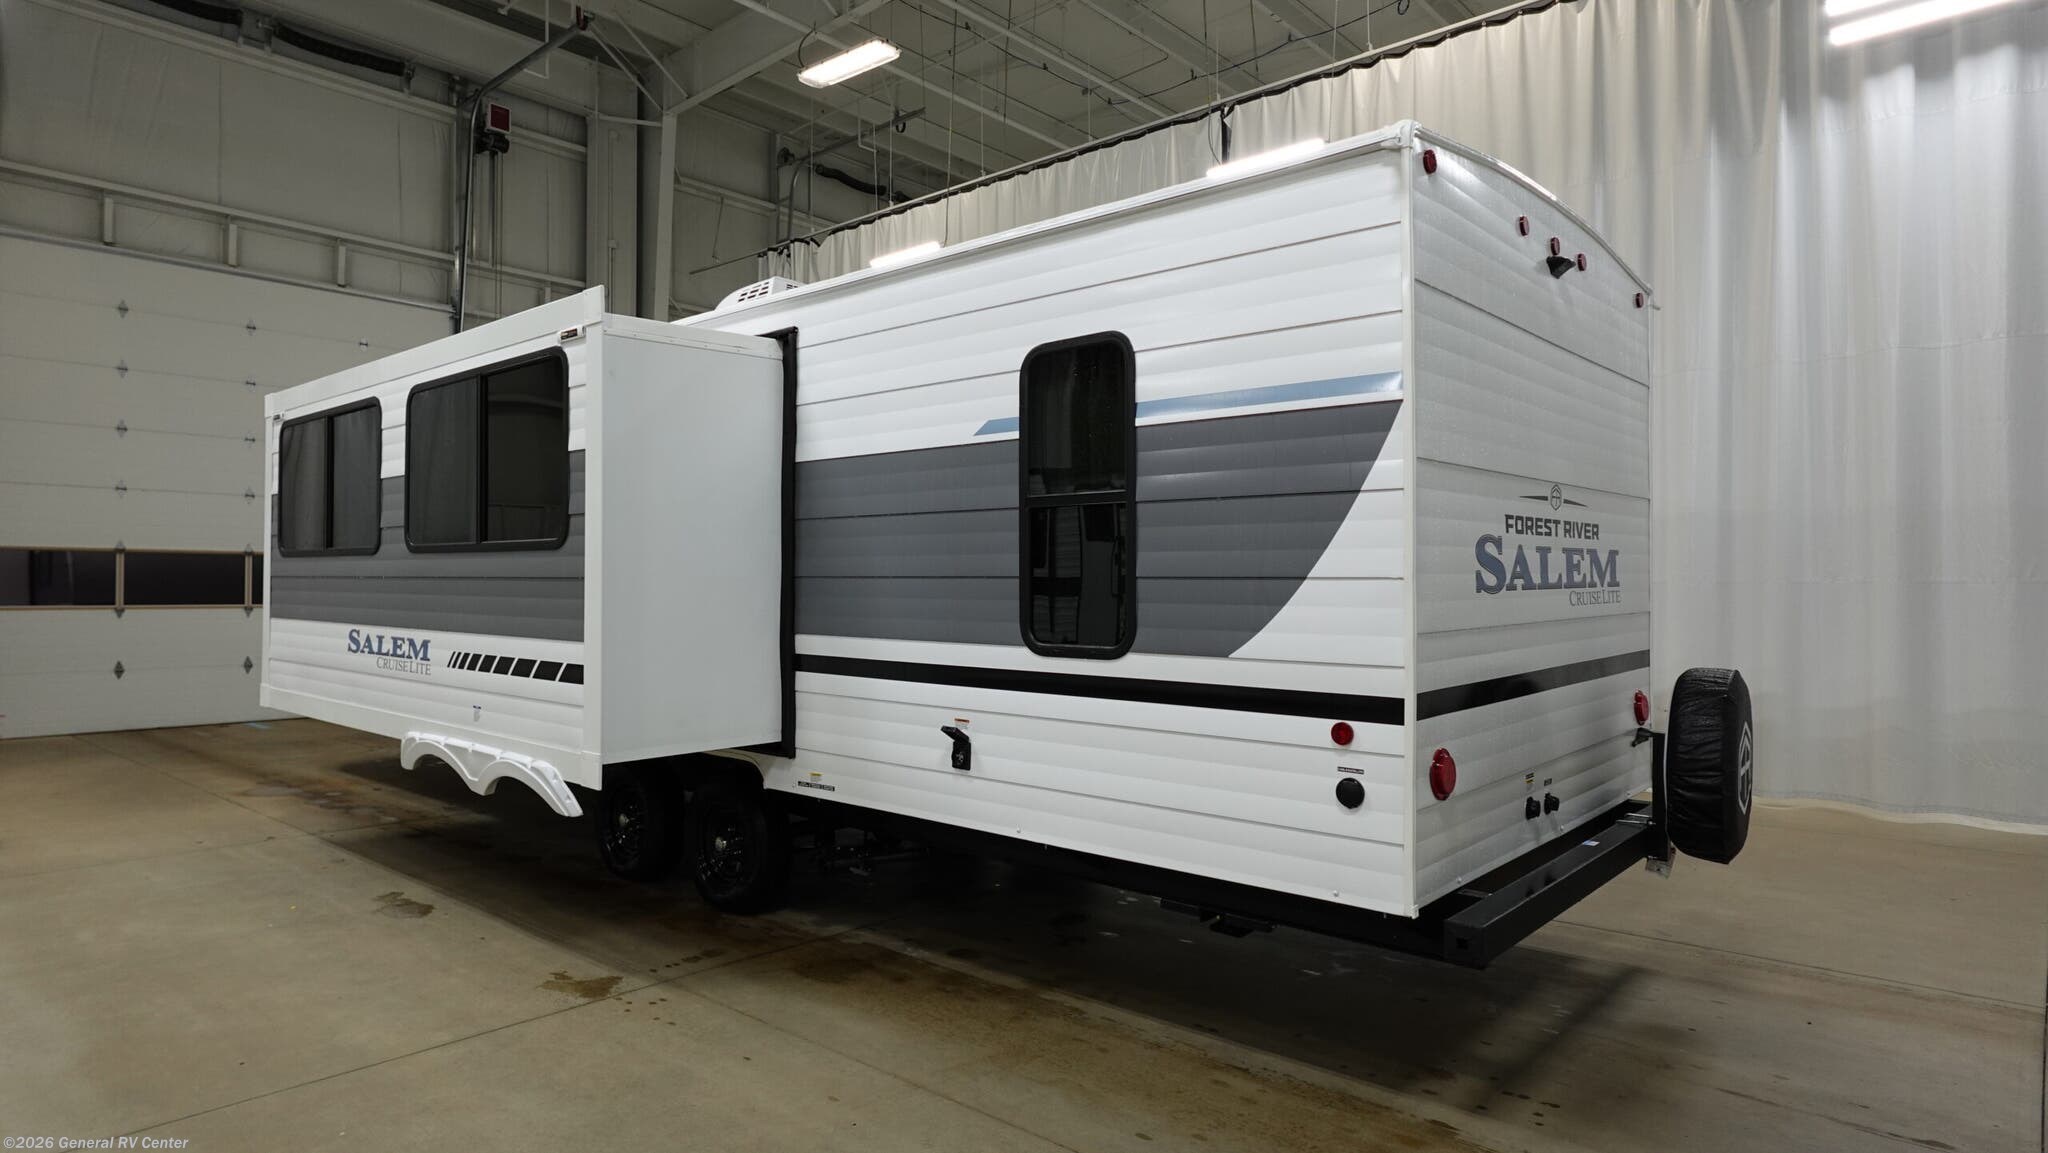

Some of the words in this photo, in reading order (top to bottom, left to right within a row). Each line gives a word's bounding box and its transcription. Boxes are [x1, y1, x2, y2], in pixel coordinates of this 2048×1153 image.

[1504, 514, 1561, 537] FOREST
[1563, 520, 1600, 540] RIVER
[1475, 533, 1620, 594] SALEM
[347, 629, 431, 661] SALEM
